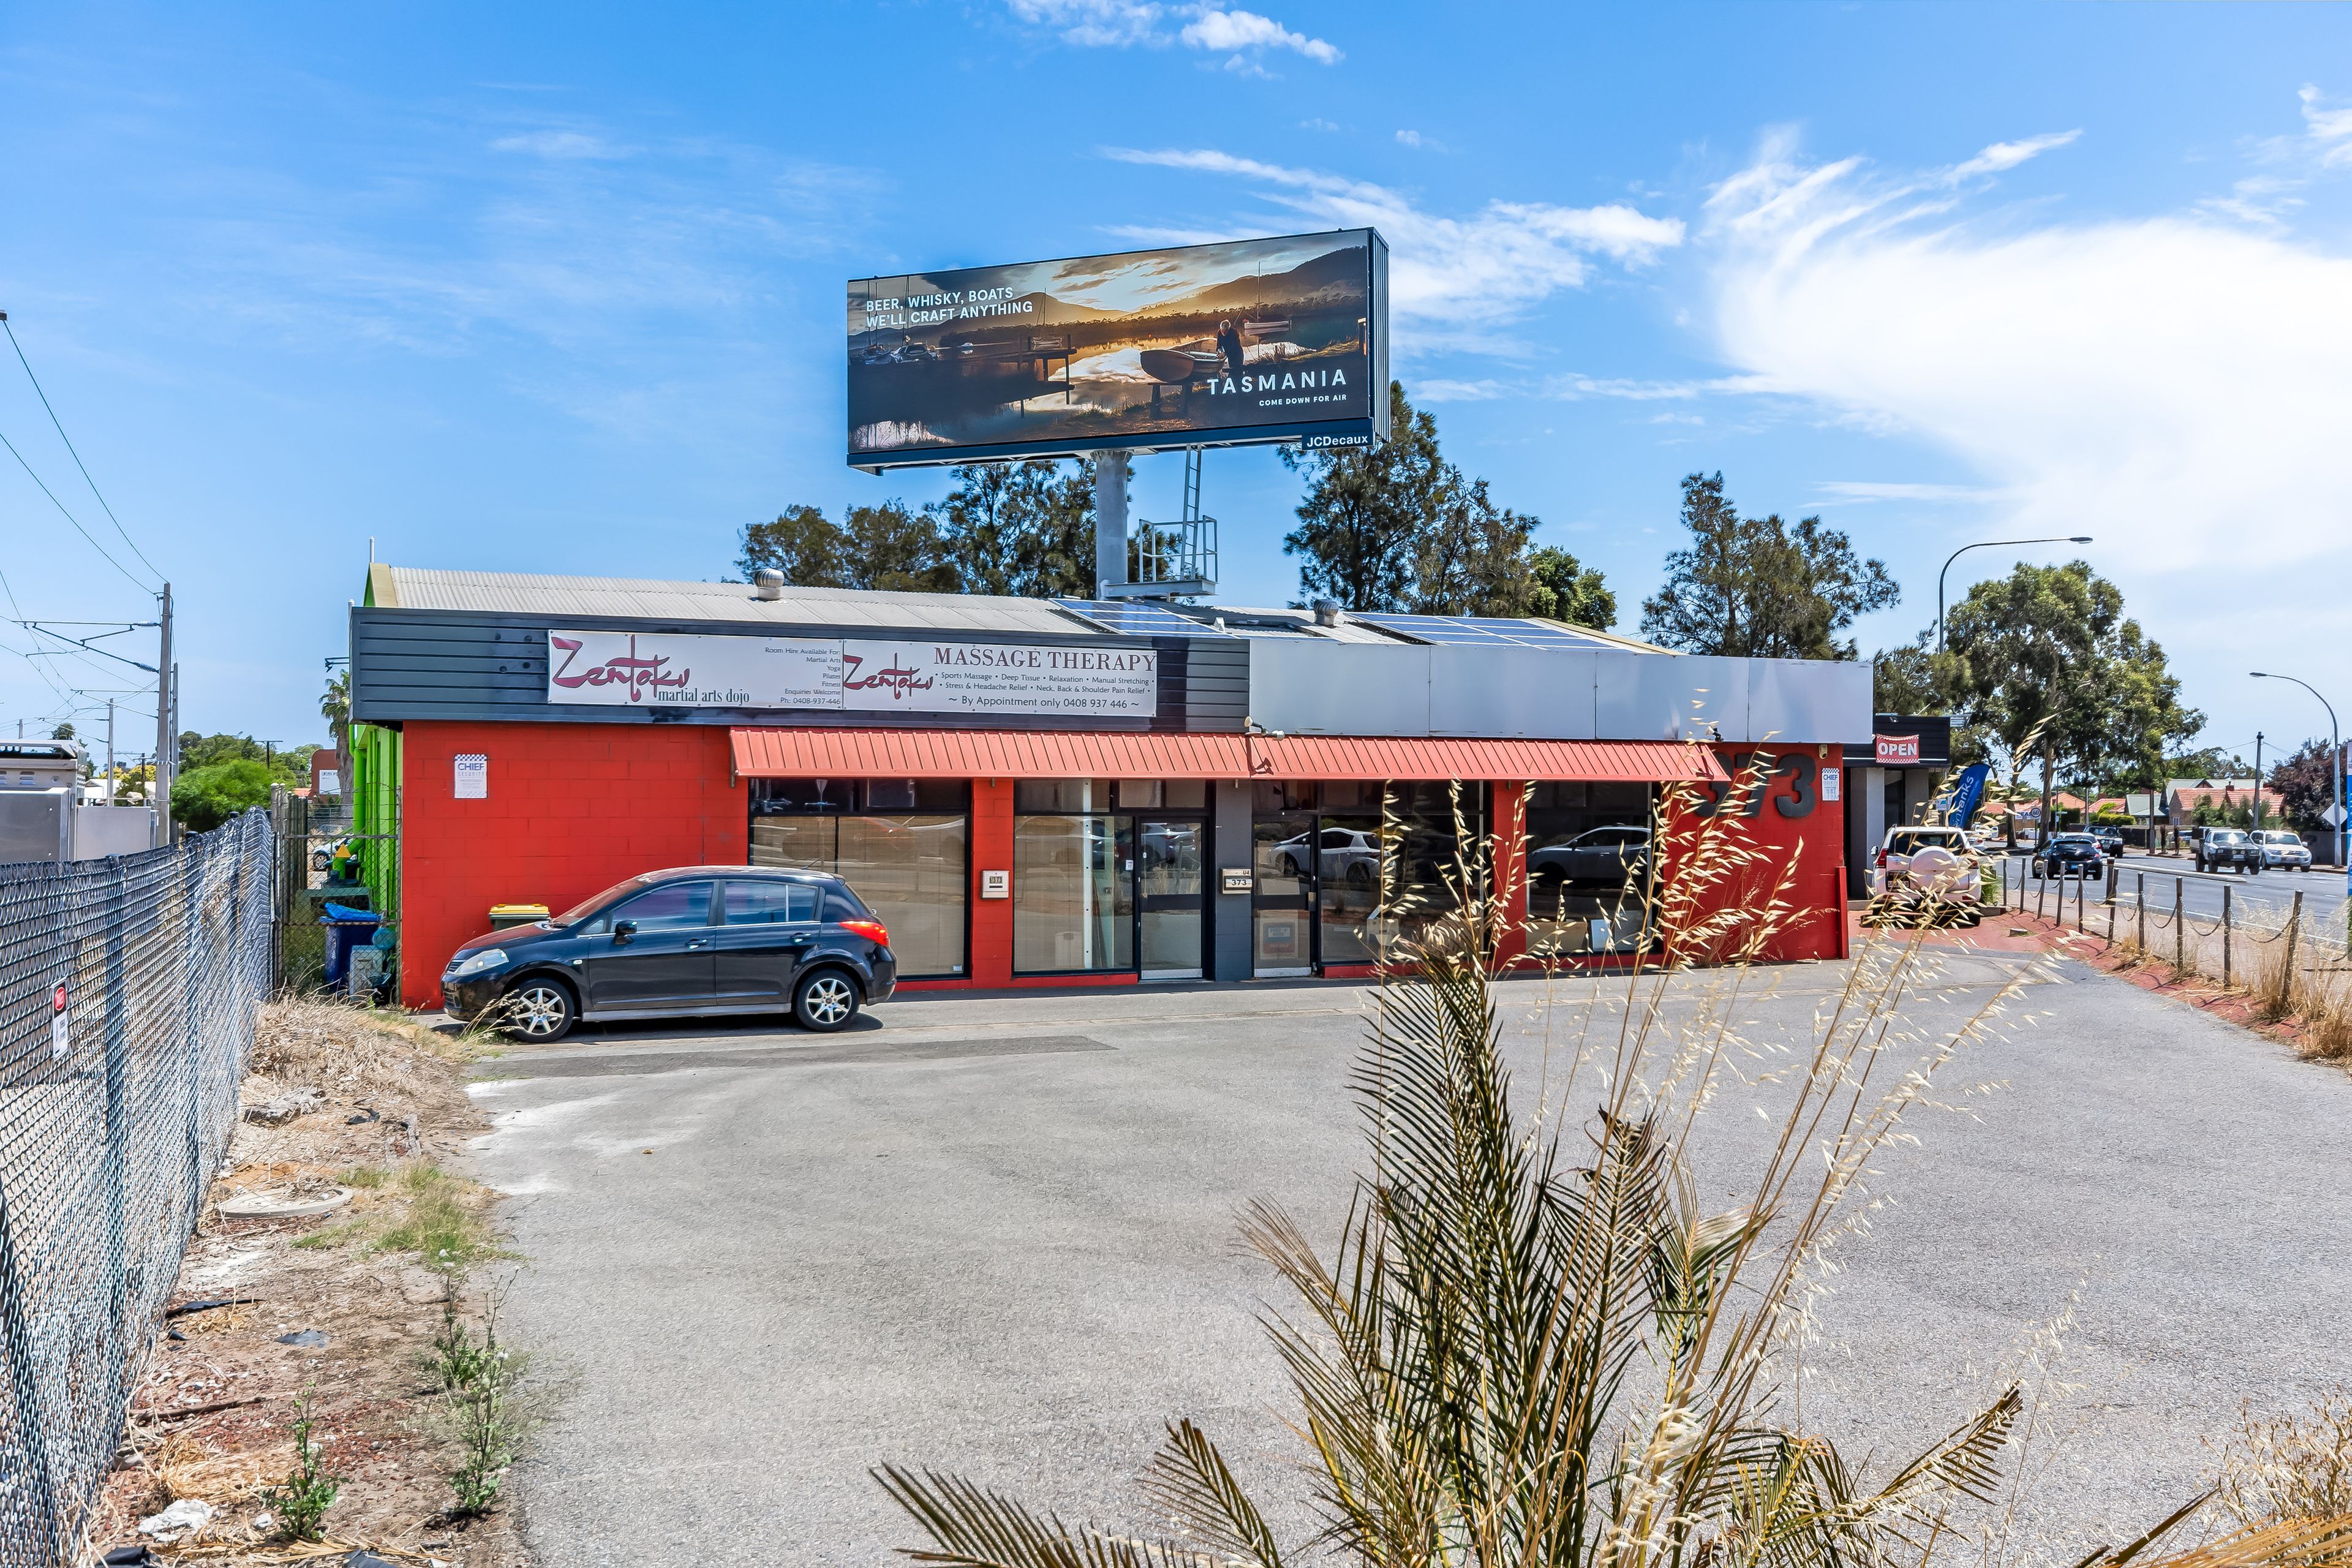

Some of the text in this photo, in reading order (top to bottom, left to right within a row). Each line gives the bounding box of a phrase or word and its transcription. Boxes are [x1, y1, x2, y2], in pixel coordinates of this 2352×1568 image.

[867, 287, 1014, 312] BEER, WHISKY, BOATS
[867, 301, 1033, 327] WE'LL CRAFT ANYTHING
[1207, 369, 1346, 395] TASMANIA
[1306, 435, 1368, 447] JCDecaux
[934, 647, 1156, 672] MASSAGE THERAPY
[964, 673, 992, 681] Massage
[1118, 677, 1149, 686] Stretching
[658, 688, 750, 705] martial arts dojo
[962, 695, 1128, 708] By Appointment only 0408 937 446
[1878, 742, 1917, 756] OPEN
